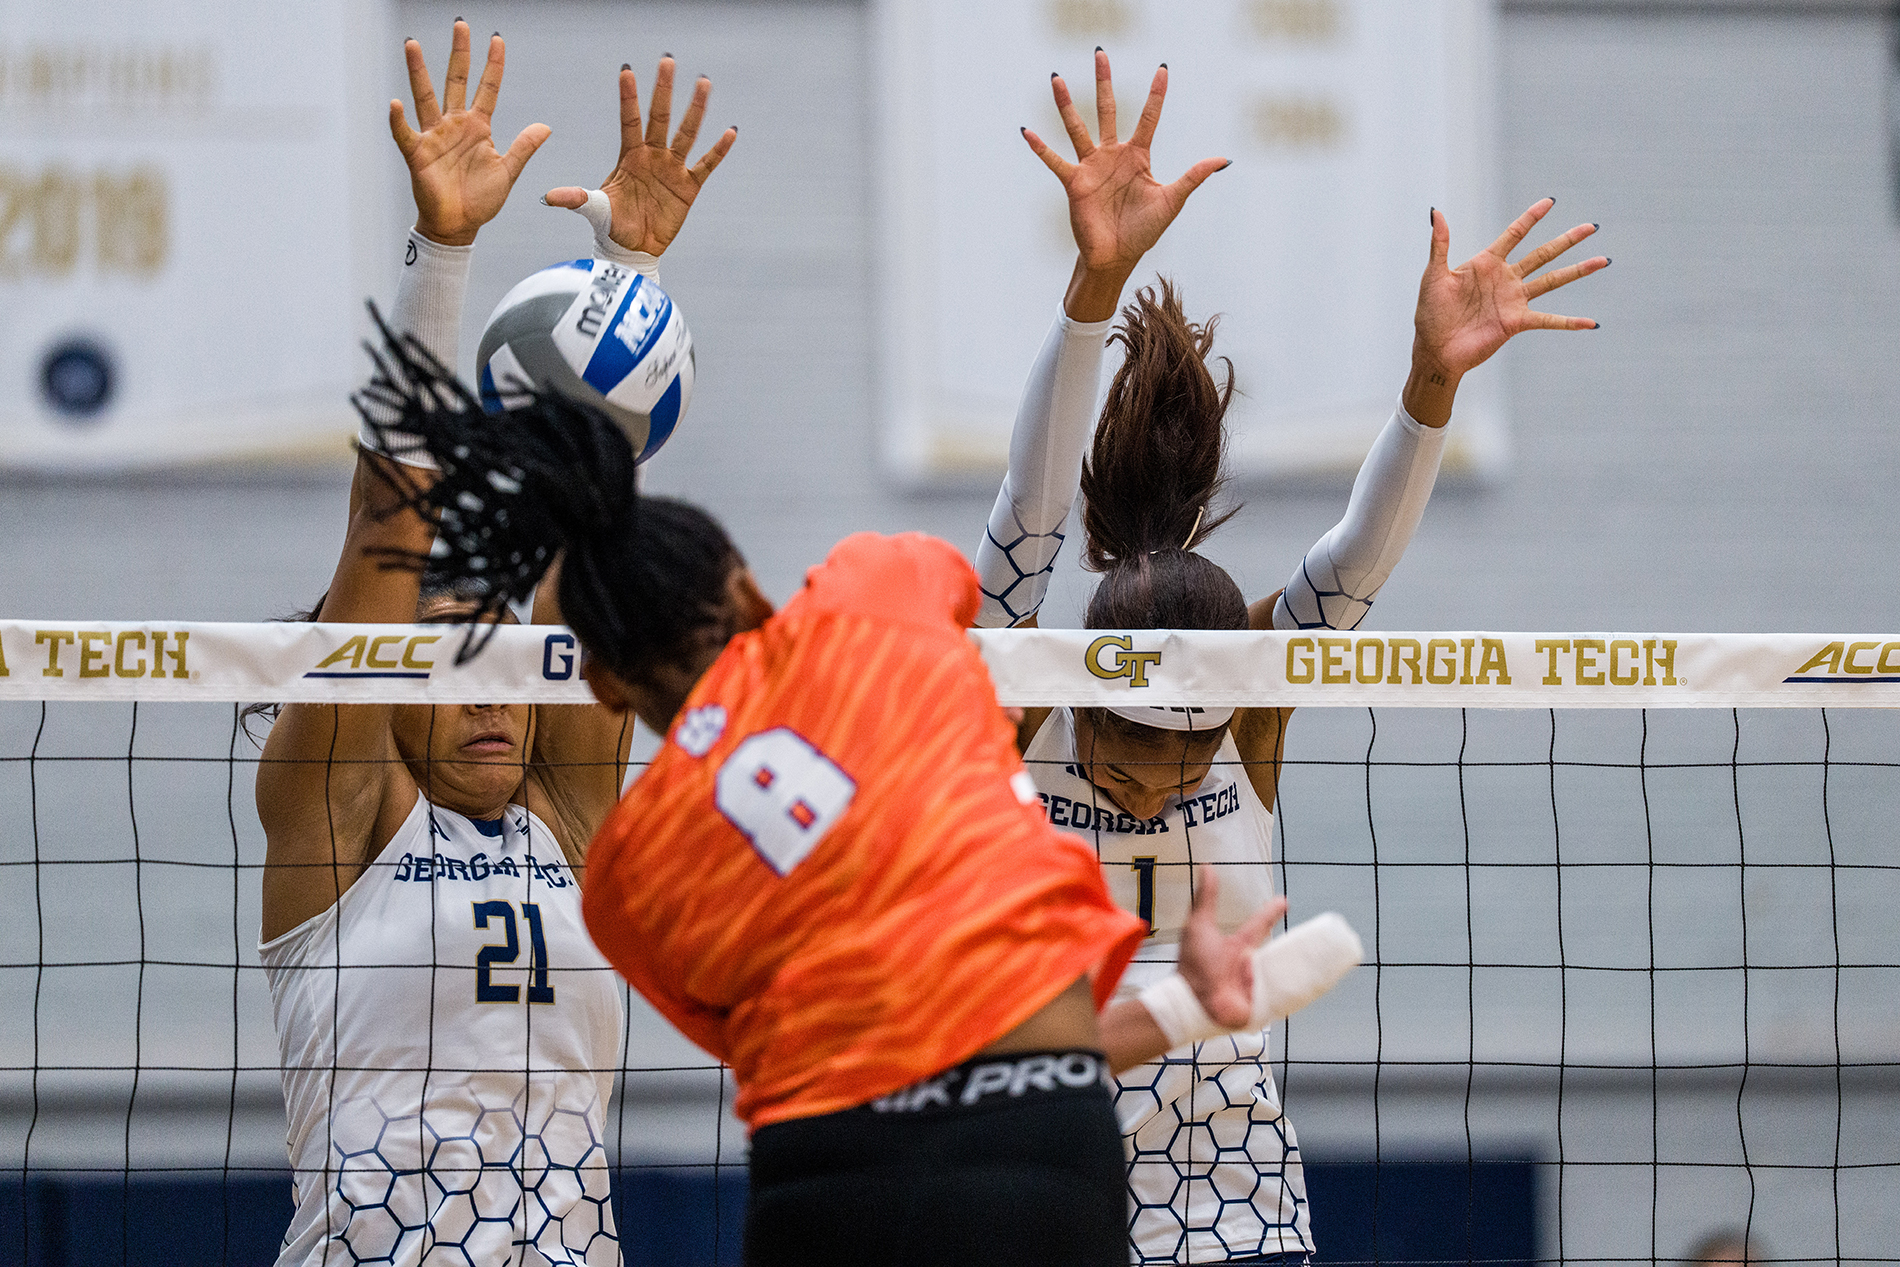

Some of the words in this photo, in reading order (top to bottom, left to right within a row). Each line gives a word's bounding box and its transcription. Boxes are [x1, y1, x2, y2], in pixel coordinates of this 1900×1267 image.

[35, 630, 190, 679] TECH
[315, 635, 442, 669] ACC
[1085, 635, 1161, 687] GT
[1286, 638, 1512, 685] GEORGIA
[1535, 639, 1678, 686] TECH
[1794, 641, 1900, 674] ACC
[713, 725, 858, 878] 8
[1175, 781, 1241, 828] TECH
[1131, 855, 1159, 938] 1
[471, 899, 556, 1005] 21
[959, 1053, 1099, 1106] PRO
